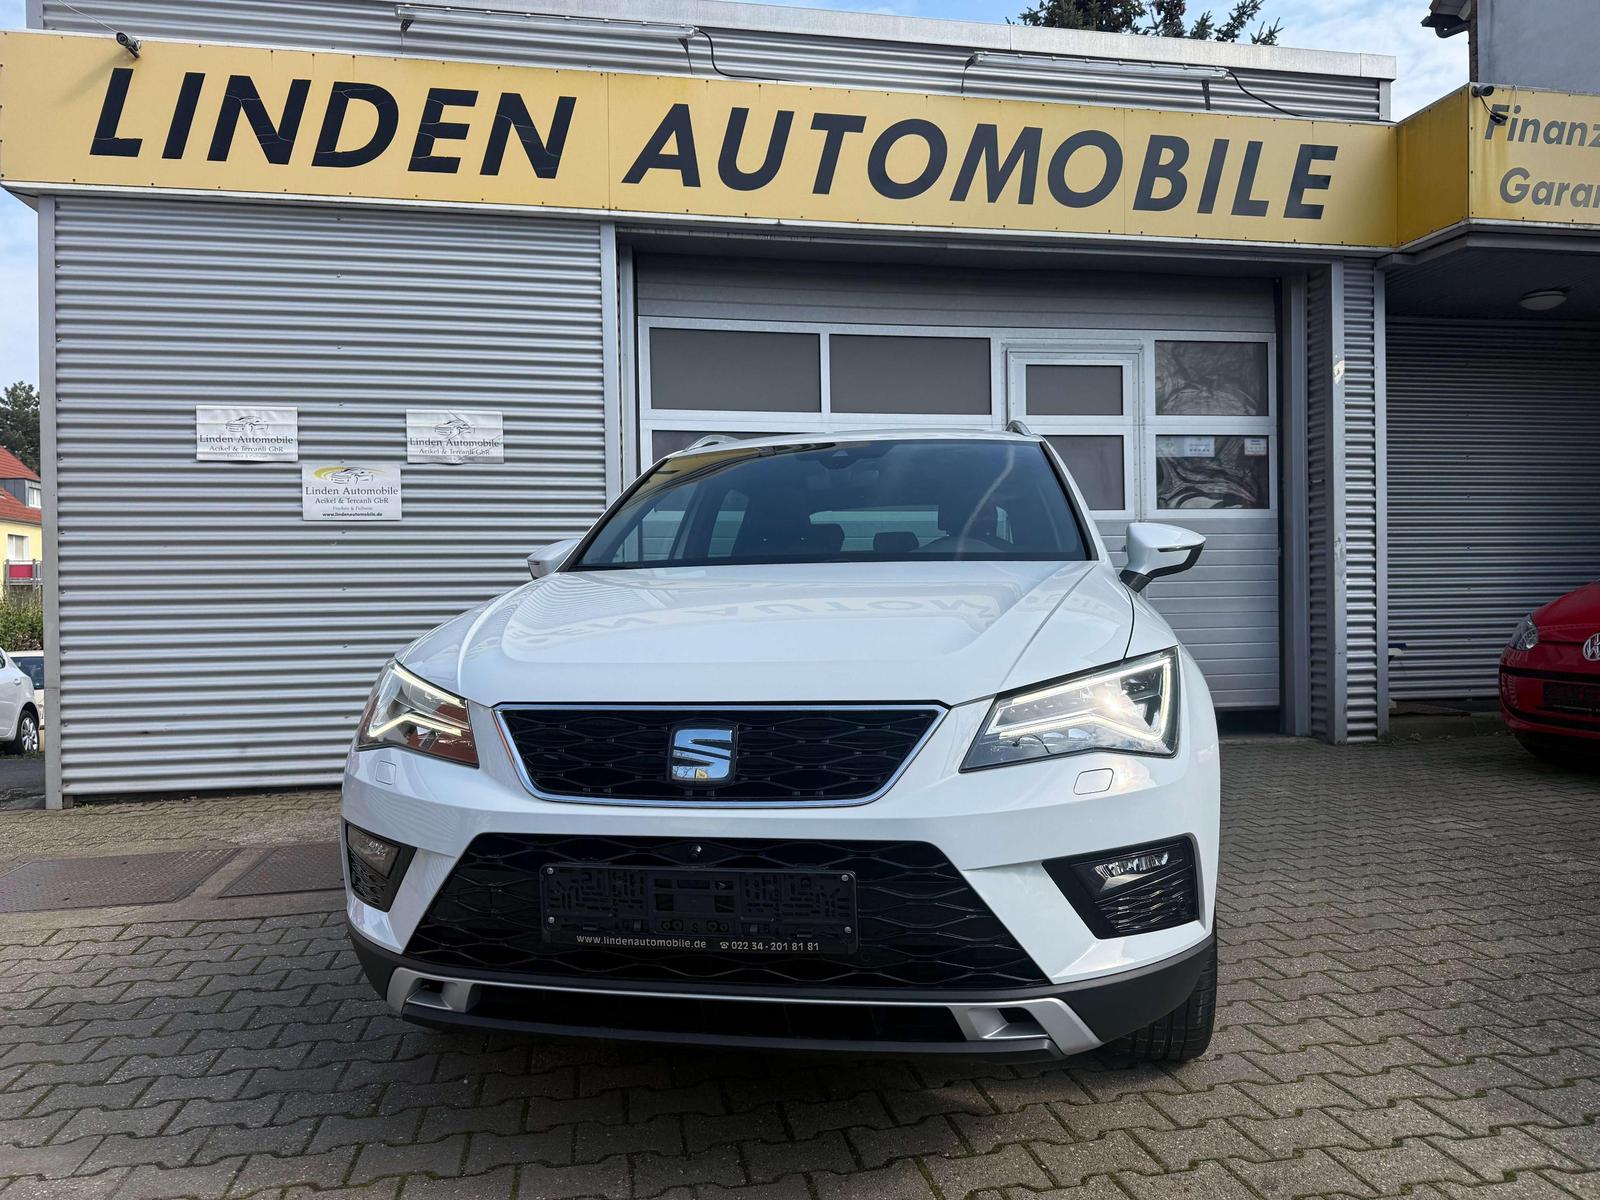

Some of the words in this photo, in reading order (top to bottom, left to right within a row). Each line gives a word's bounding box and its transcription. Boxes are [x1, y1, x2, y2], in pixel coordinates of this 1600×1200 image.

[89, 67, 577, 180] LINDEN
[621, 102, 1338, 220] AUTOMOBILE
[199, 434, 234, 443] Linden
[237, 435, 294, 444] Automobile
[409, 437, 442, 446] Linden
[446, 438, 500, 447] Automobile
[305, 486, 339, 495] Linden
[342, 486, 399, 495] Automobile
[576, 935, 707, 949] www.lindenautomobile.de
[731, 941, 749, 950] 022
[791, 942, 804, 951] 81
[807, 942, 819, 951] 81
